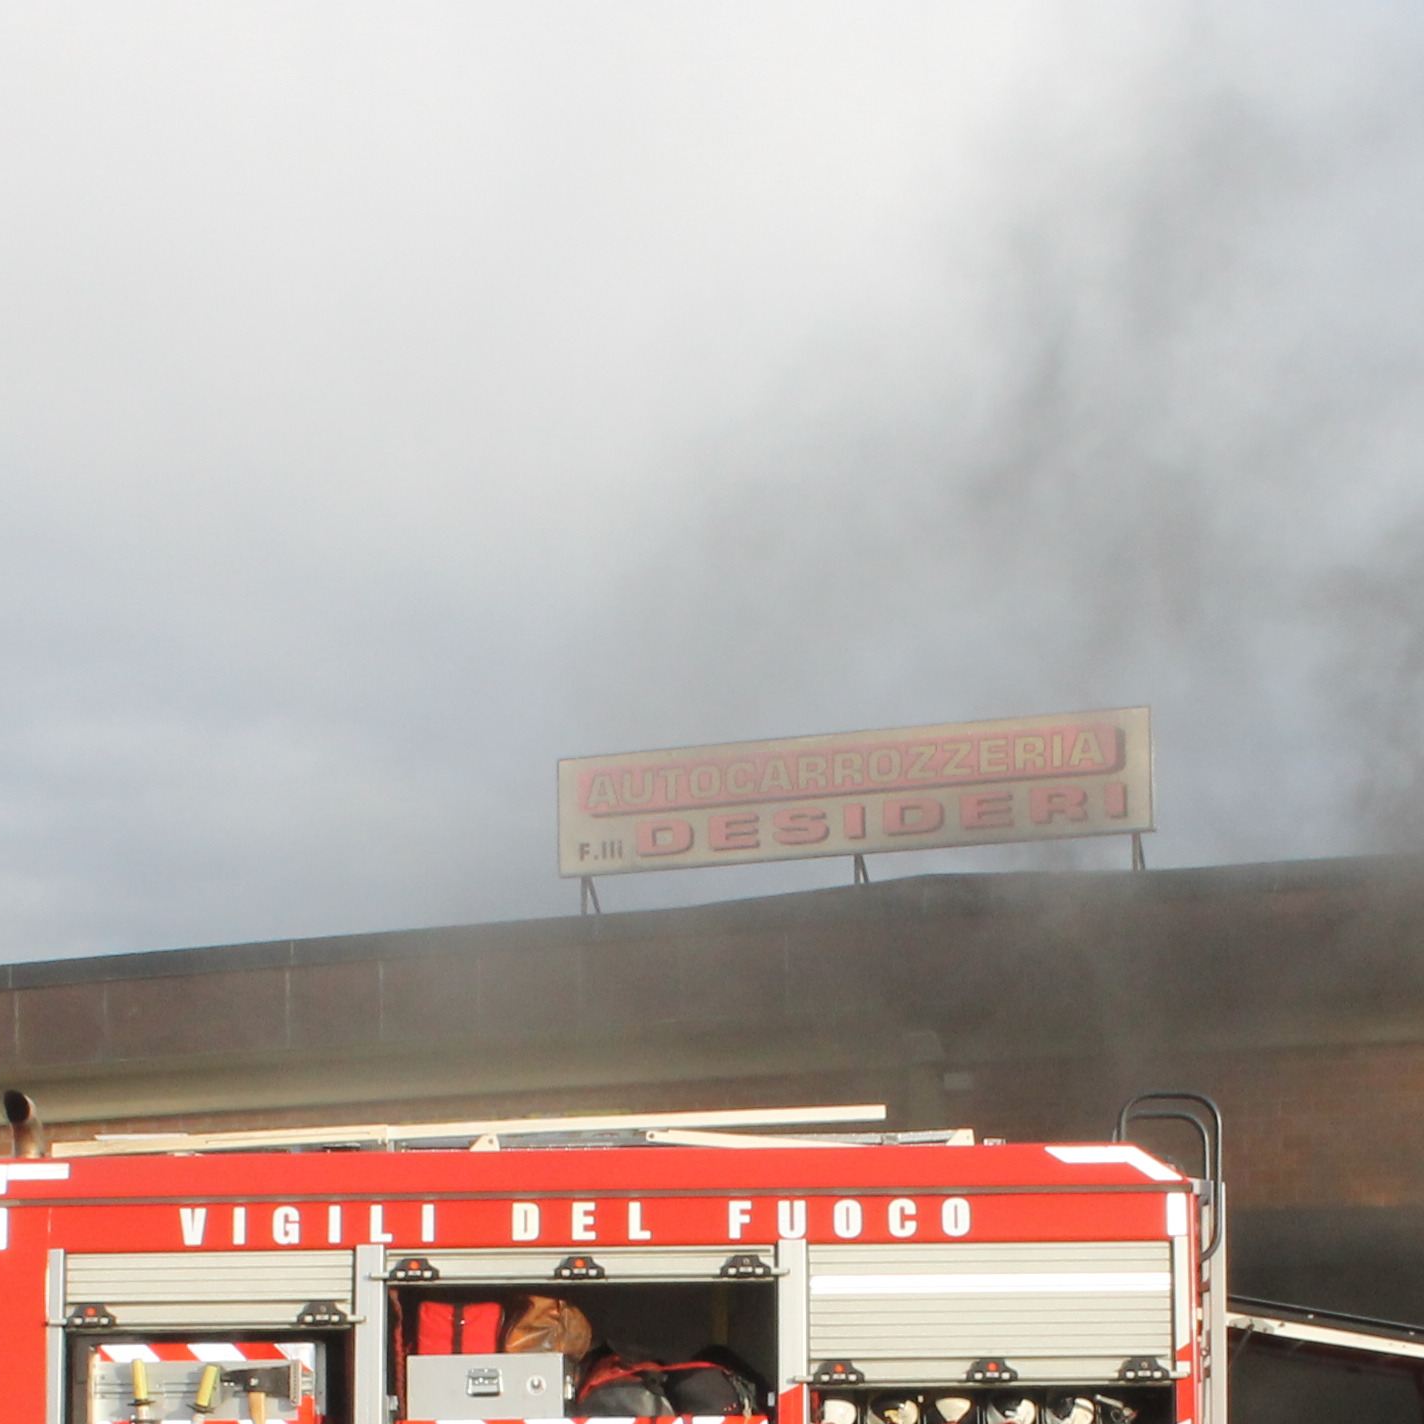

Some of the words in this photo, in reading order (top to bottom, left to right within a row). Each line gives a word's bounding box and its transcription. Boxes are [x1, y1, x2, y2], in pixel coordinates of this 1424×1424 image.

[586, 731, 1106, 811] AUTOCARROZZERIA
[636, 781, 1128, 857] DESIDERI
[179, 1203, 436, 1246] VIGILI
[512, 1201, 652, 1242] DEL
[728, 1197, 972, 1241] FUOCO
